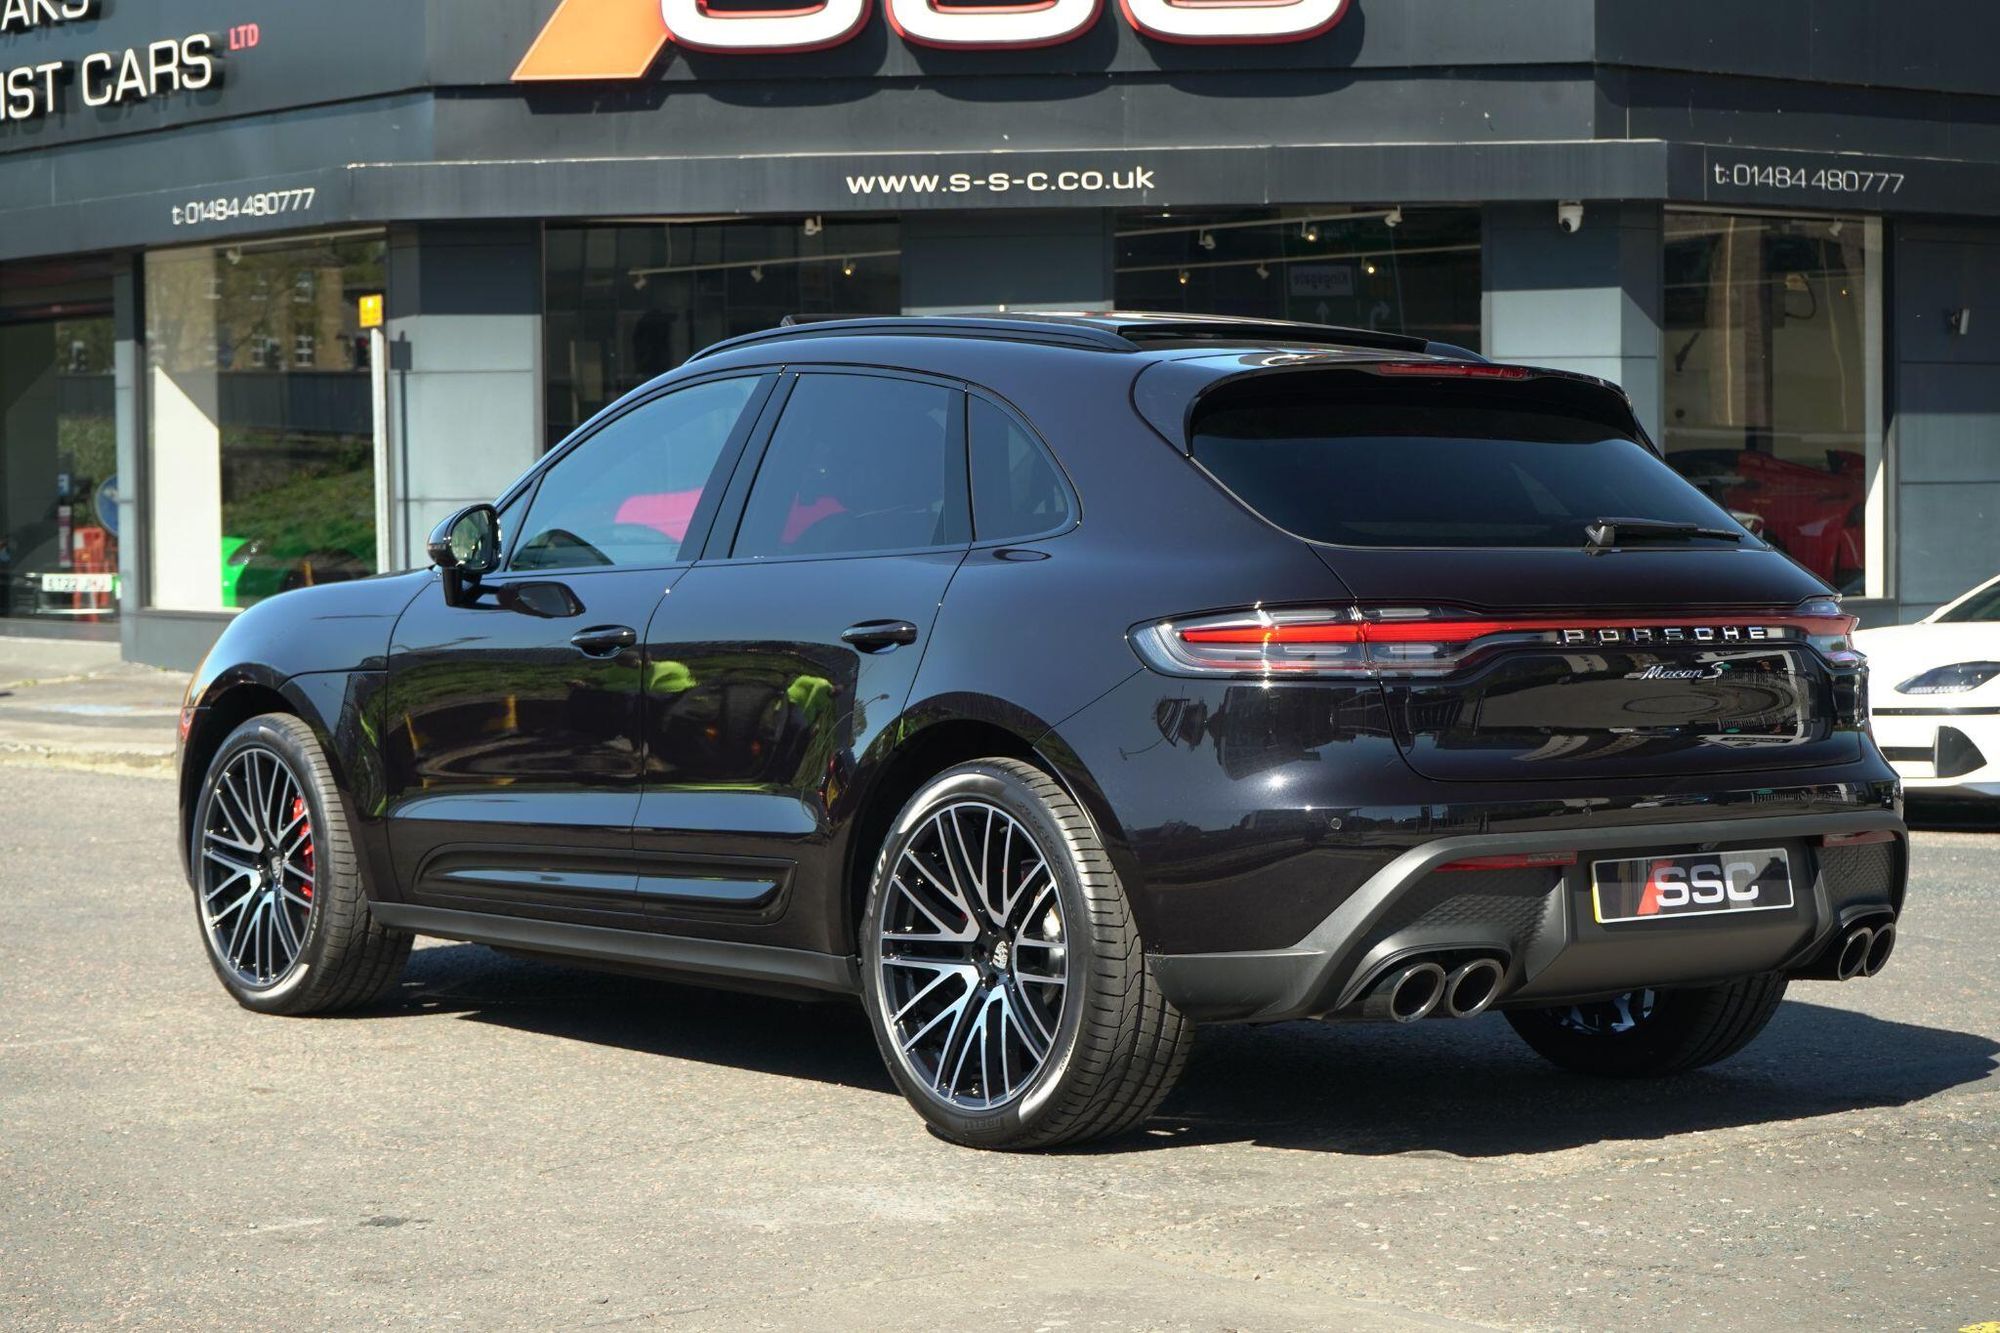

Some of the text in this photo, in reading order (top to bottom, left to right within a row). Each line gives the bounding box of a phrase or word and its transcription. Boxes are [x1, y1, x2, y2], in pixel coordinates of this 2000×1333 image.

[82, 33, 212, 106] CARS
[229, 23, 260, 51] LTD
[846, 166, 1155, 194] www.s-s-c.co.uk
[1811, 169, 1905, 194] 480777
[1563, 626, 1765, 643] PORSCHE
[1641, 661, 1725, 680] Macan S
[1654, 862, 1760, 907] SSC
